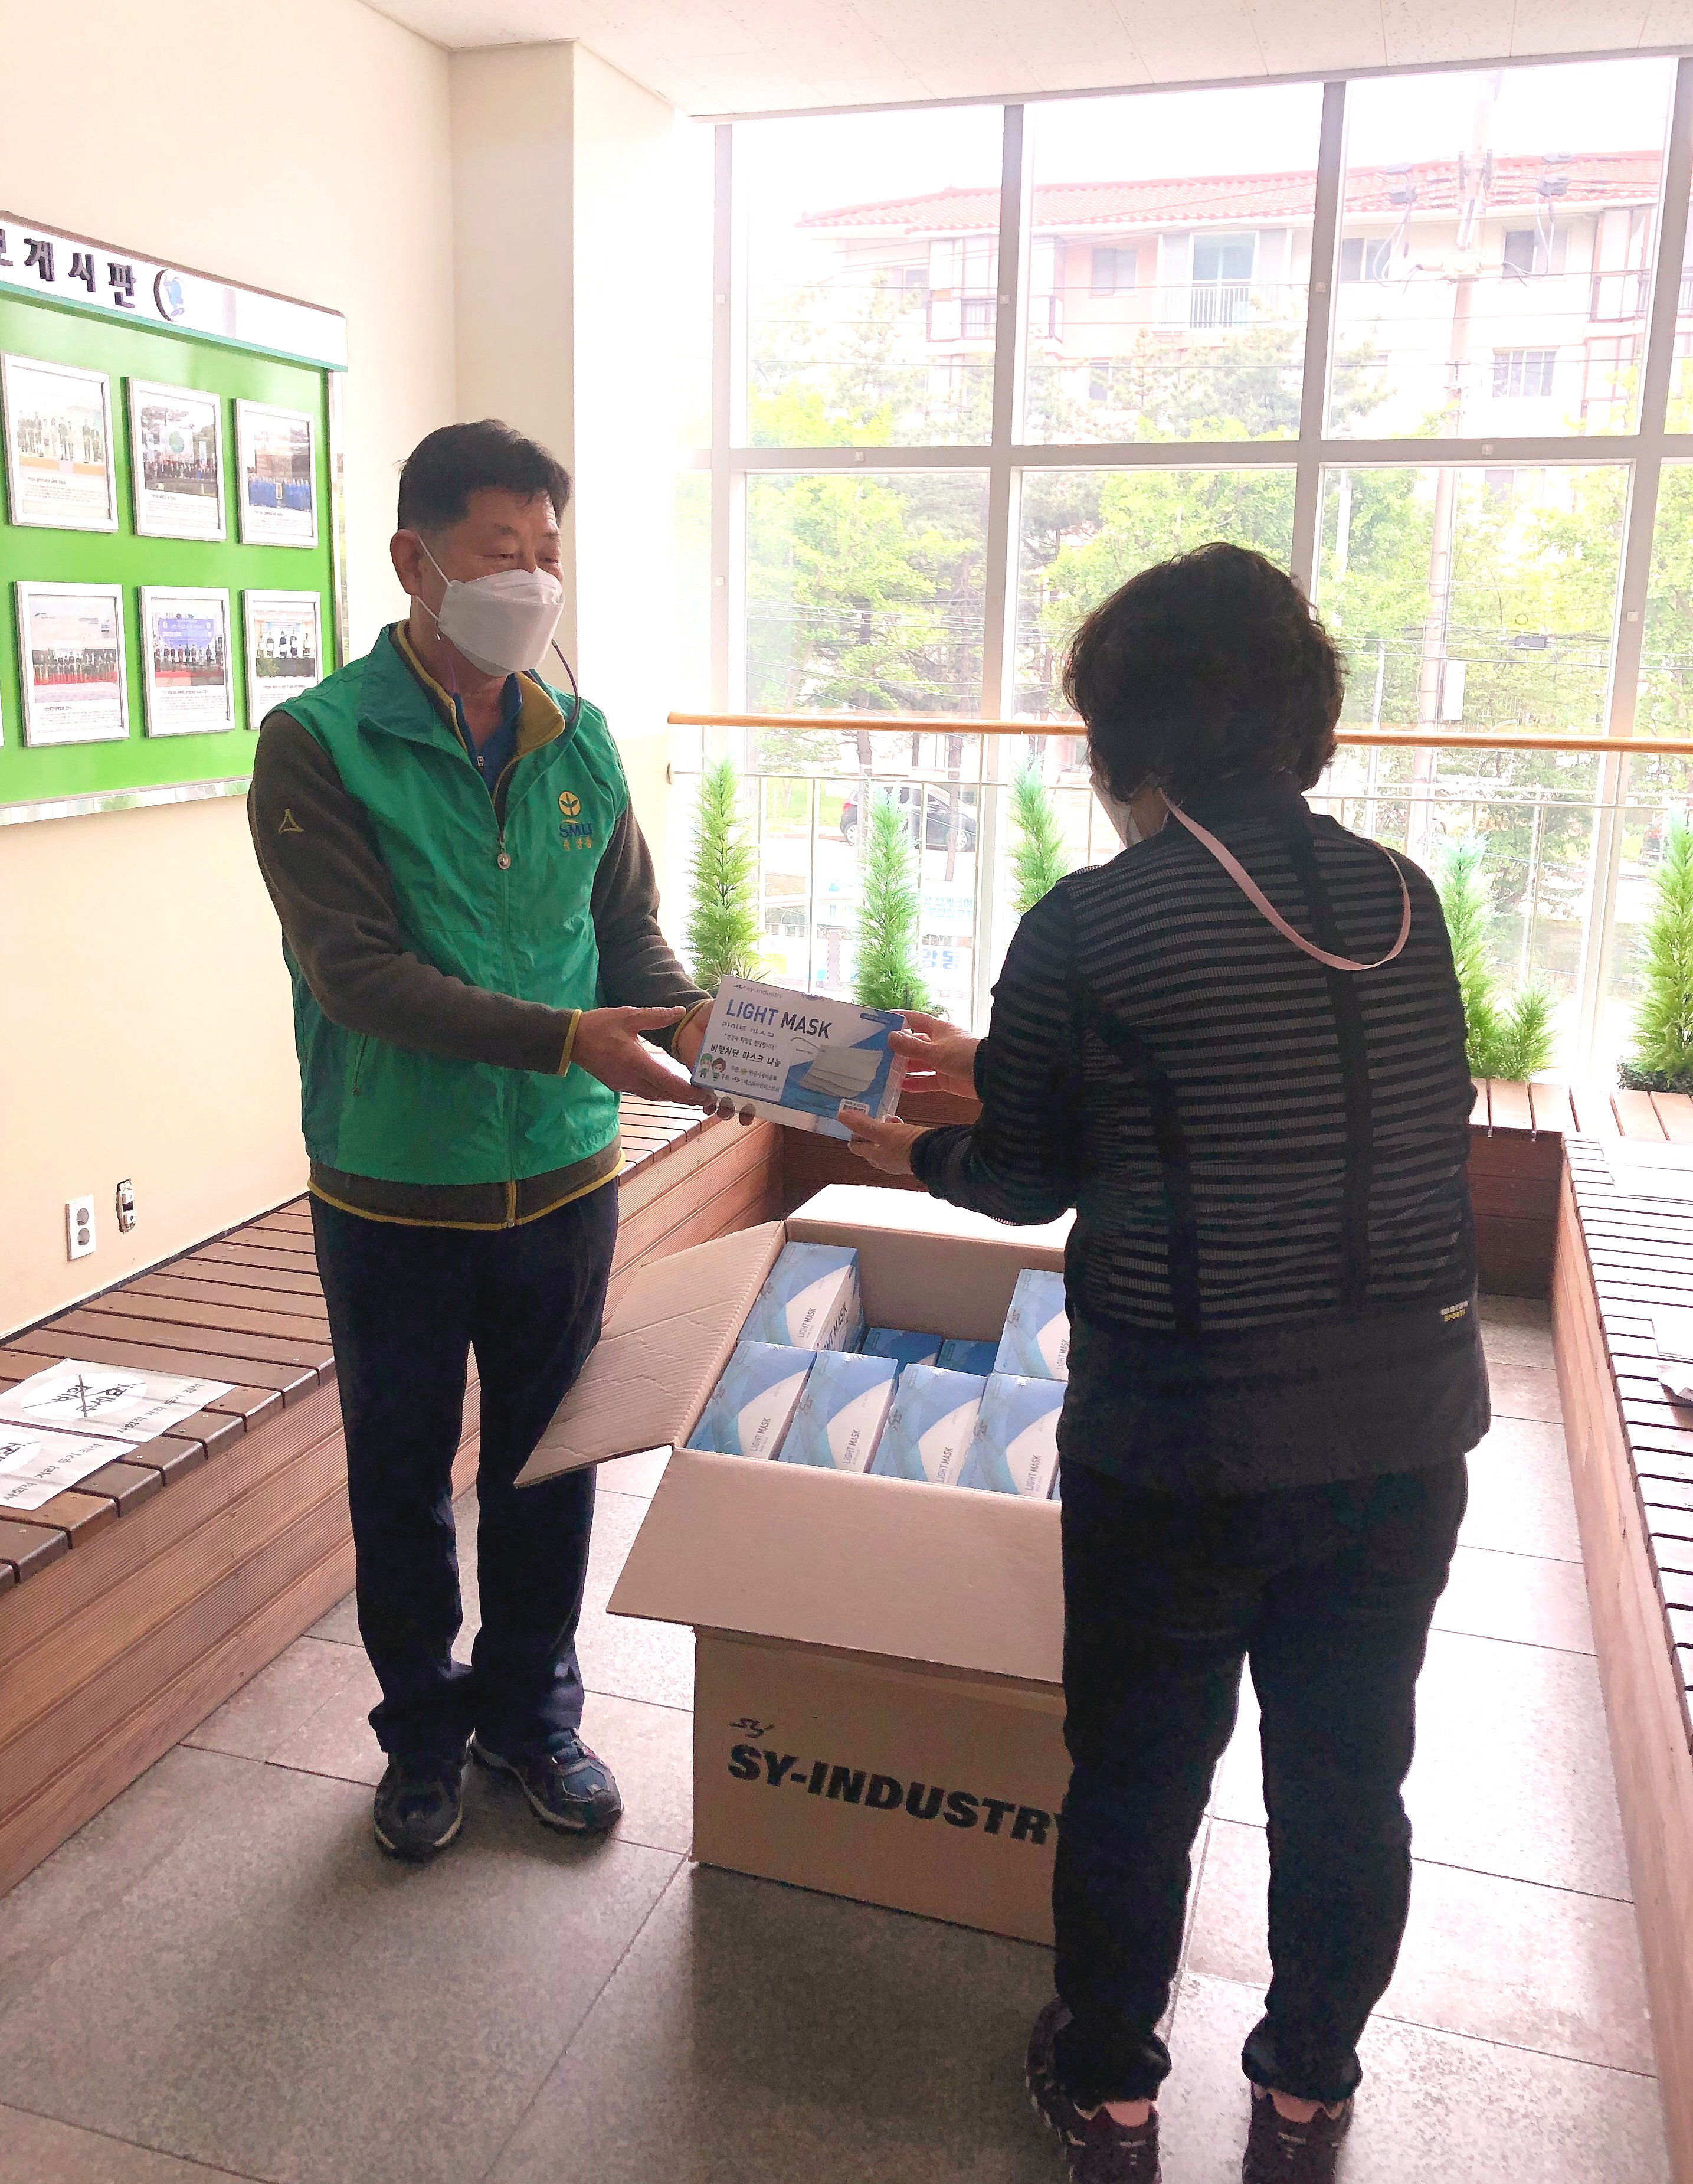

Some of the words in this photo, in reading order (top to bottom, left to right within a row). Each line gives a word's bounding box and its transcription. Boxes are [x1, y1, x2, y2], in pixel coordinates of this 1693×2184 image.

[722, 1021, 746, 1031] 라이트
[750, 1028, 774, 1038] 마스크
[726, 999, 778, 1026] LIGHT
[780, 1011, 833, 1038] MASK
[710, 1043, 740, 1058] 비말차단
[741, 1051, 764, 1063] 마스크
[766, 1056, 781, 1068] 나눔
[797, 1322, 810, 1338] LIGHT
[807, 1307, 816, 1322] MASK
[833, 1302, 847, 1335] MASK
[117, 1417, 148, 1433] 사회적
[144, 1406, 166, 1416] 거리
[164, 1394, 186, 1405] 두기
[750, 1433, 764, 1451] LIGHT
[758, 1417, 771, 1436] MASK
[848, 1429, 861, 1447] MASK
[843, 1446, 855, 1464] LIGHT
[936, 1465, 947, 1483] LIGHT
[944, 1447, 954, 1466] MASK
[1029, 1454, 1042, 1474] MASK
[3, 1482, 38, 1500] 사회적
[34, 1466, 60, 1479] 거리
[57, 1453, 81, 1464] 두기
[1025, 1472, 1037, 1491] LIGHT
